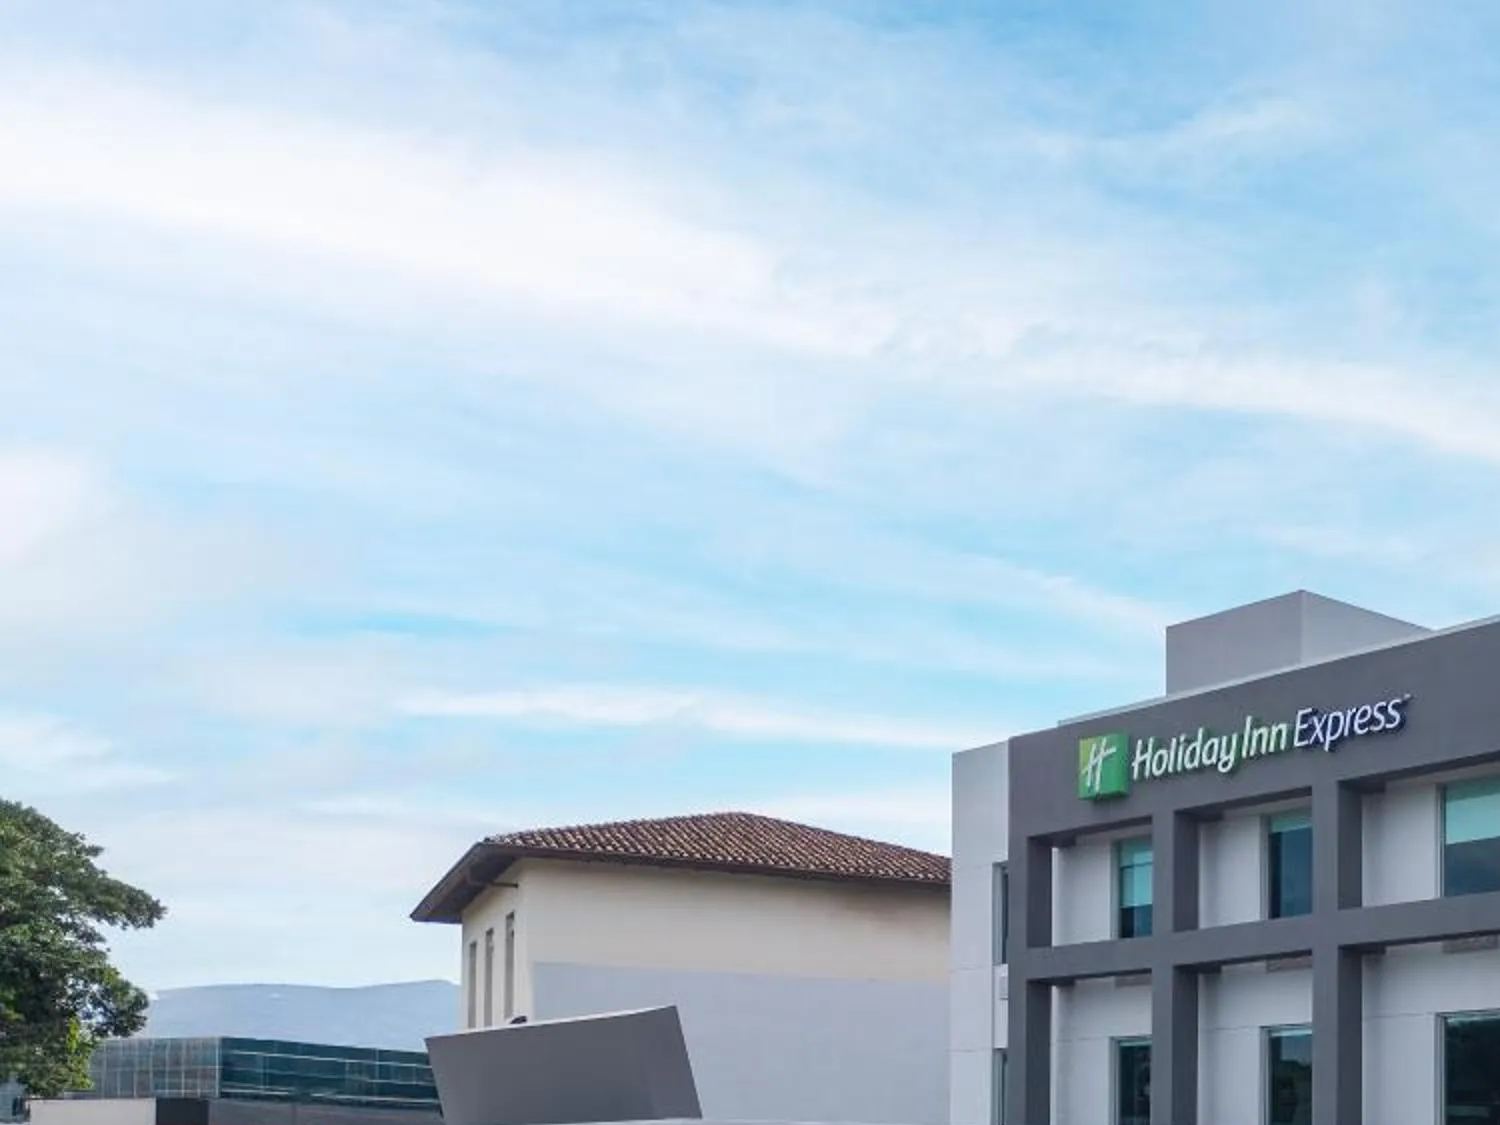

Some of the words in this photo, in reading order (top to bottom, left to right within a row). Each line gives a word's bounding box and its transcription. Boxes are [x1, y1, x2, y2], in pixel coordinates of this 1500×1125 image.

[1132, 727, 1238, 780] Holiday
[1241, 715, 1287, 759] Inn
[1294, 698, 1402, 752] Express
